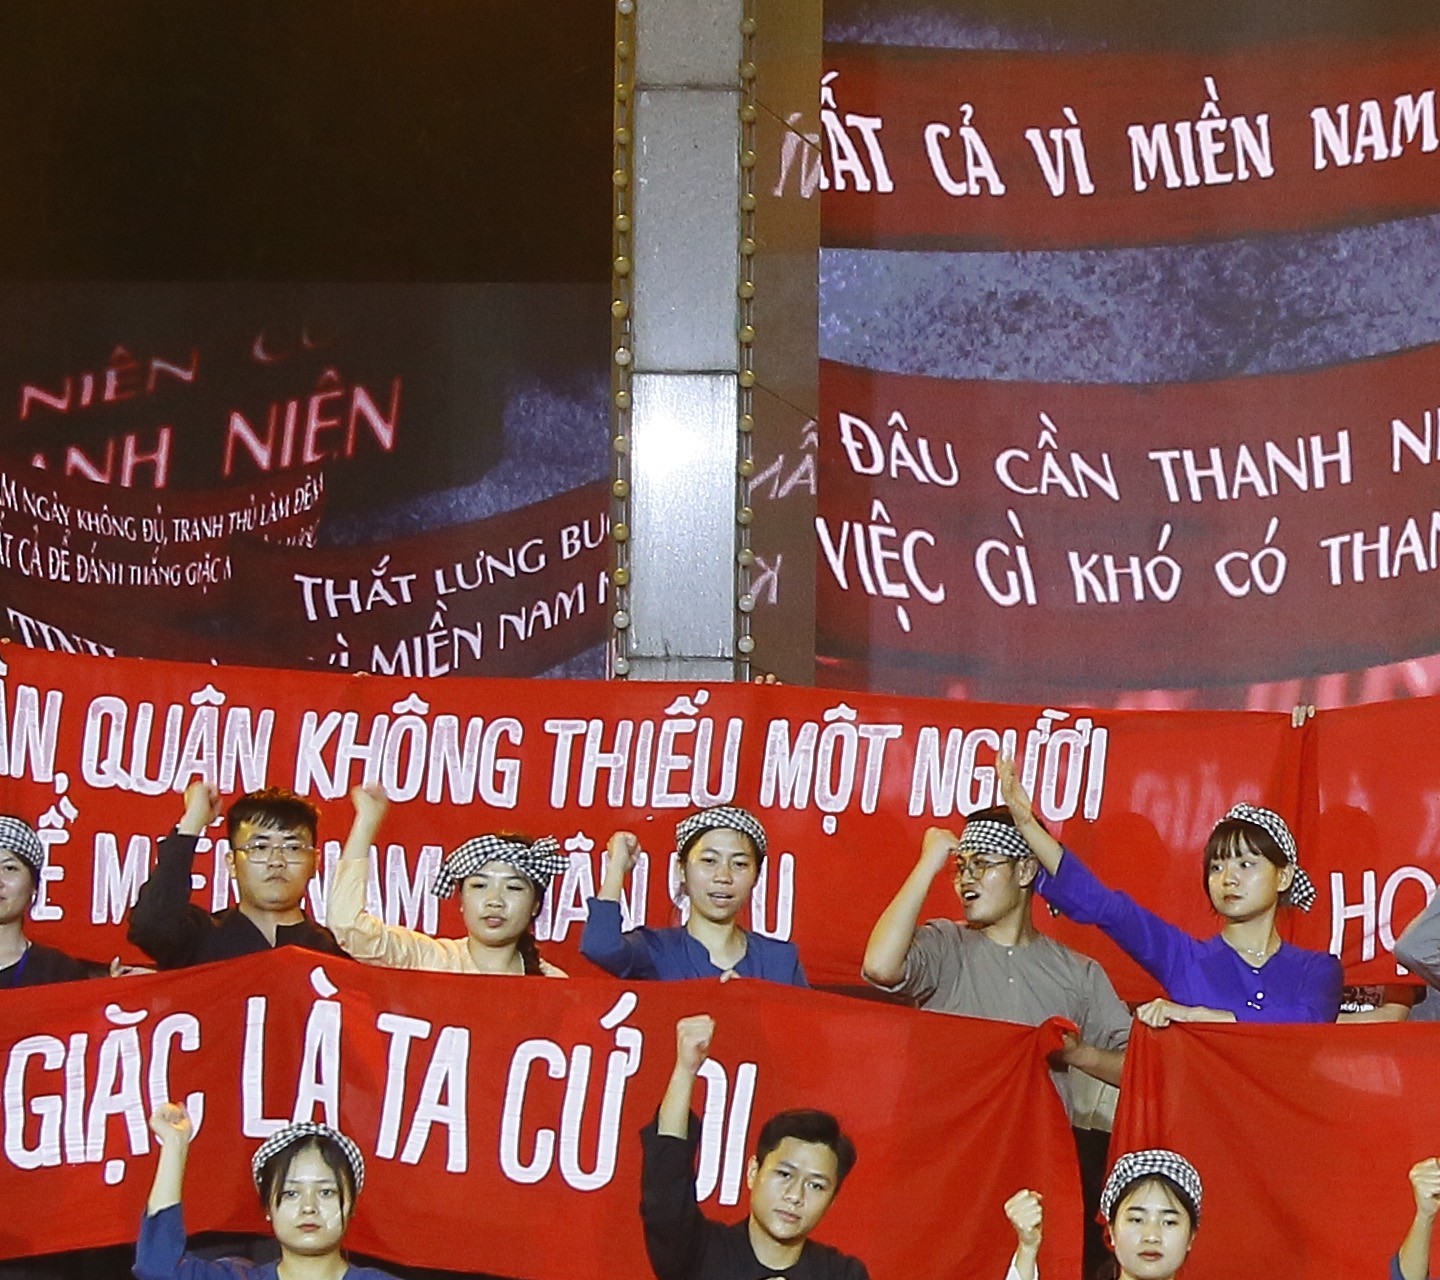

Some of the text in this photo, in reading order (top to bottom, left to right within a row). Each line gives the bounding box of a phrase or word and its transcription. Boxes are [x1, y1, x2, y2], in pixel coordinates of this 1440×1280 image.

[924, 103, 1005, 198] CẢ
[1024, 107, 1096, 197] VÌ
[1130, 75, 1274, 192] MIỀN
[1310, 87, 1439, 170] NAM
[222, 365, 404, 478] NIÊN
[840, 411, 959, 488] ĐÂU
[993, 413, 1123, 502] CẦN
[1150, 425, 1353, 507] THANH
[76, 504, 137, 543] KHÔNG
[435, 538, 546, 596] LƯNG
[560, 512, 610, 560] BU
[815, 498, 946, 633] VIỆC
[975, 508, 1037, 608] GÌ
[1070, 522, 1182, 607] KHÓ
[1215, 516, 1287, 597] CÓ
[371, 599, 484, 678] MIỀN
[498, 582, 586, 651] NAM
[81, 684, 275, 797] QUÂN
[295, 691, 523, 810] KHÔNG
[543, 688, 744, 810] THIẾU
[760, 702, 903, 835] MỘT
[3, 1003, 205, 1186] GIẶC
[241, 966, 344, 1139] LÀ
[373, 1011, 471, 1174] TA
[499, 990, 643, 1193] CỨ
